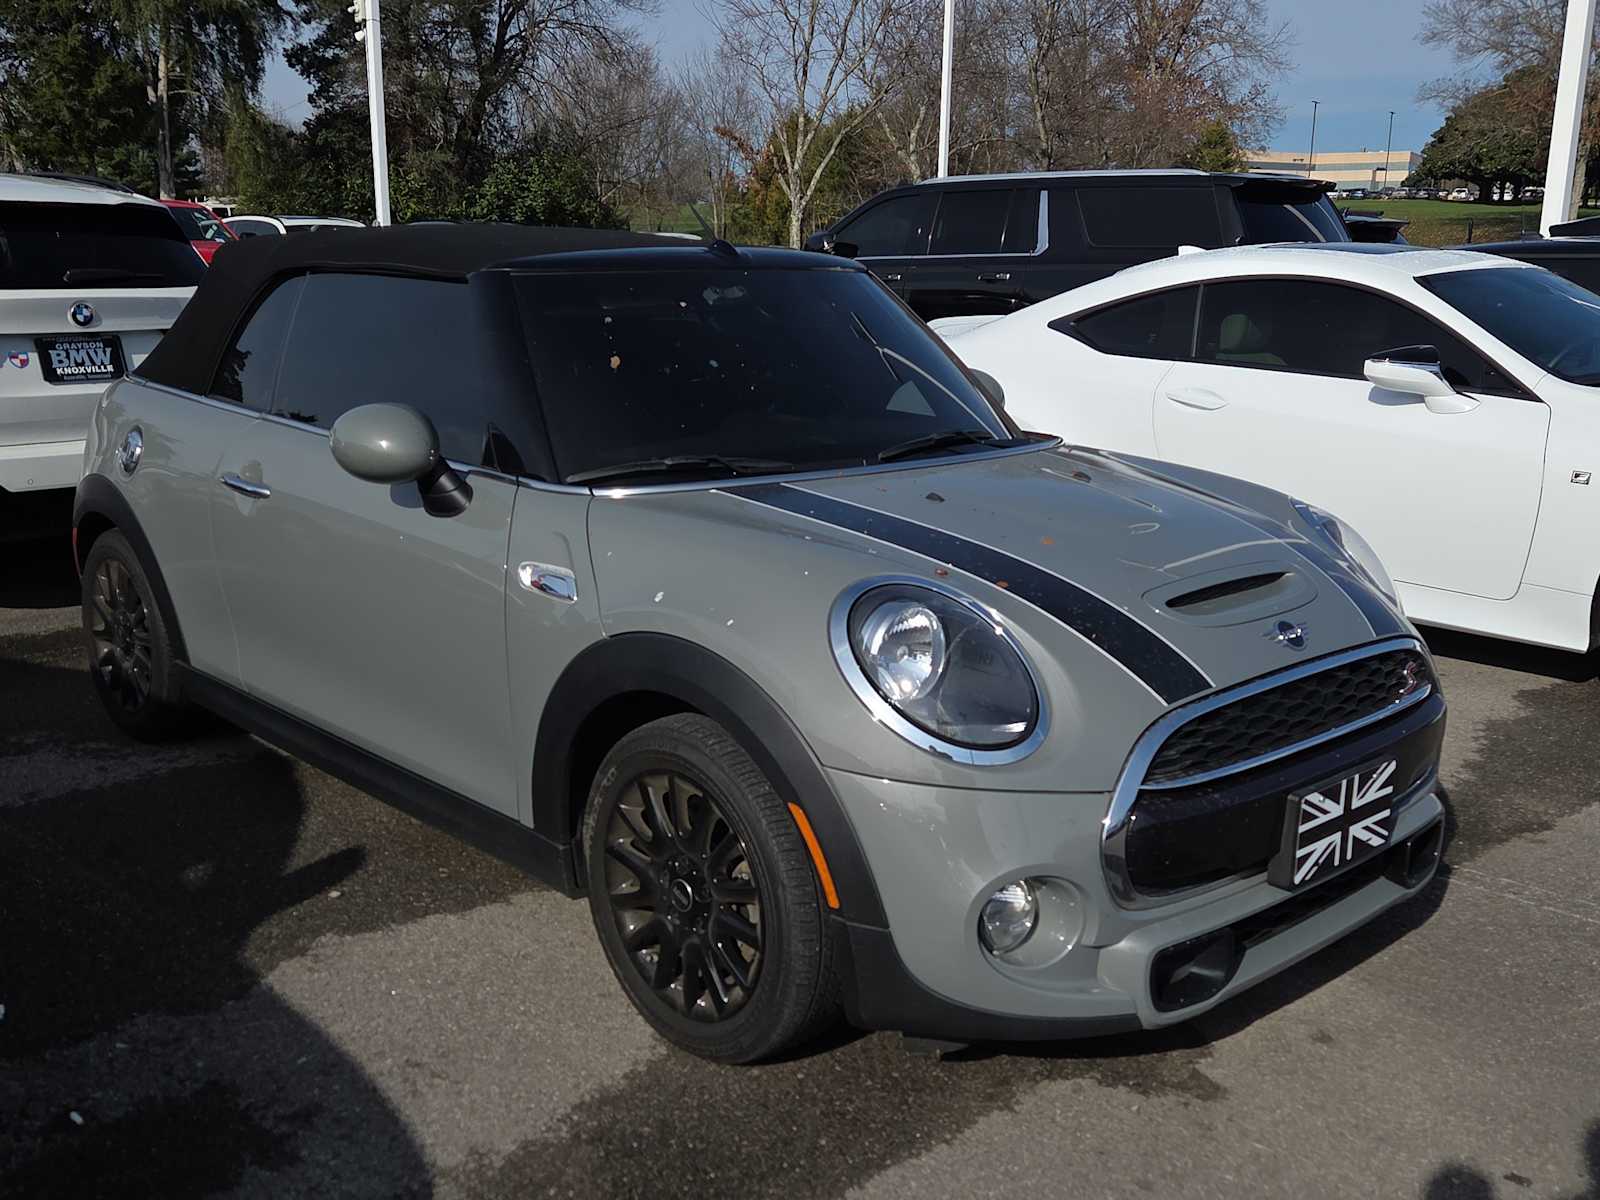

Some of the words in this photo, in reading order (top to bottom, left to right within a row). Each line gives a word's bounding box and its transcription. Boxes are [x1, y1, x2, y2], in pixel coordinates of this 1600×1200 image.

[55, 341, 104, 350] GRAYSON
[48, 347, 112, 368] BMW
[56, 364, 114, 375] KNOXVILLE
